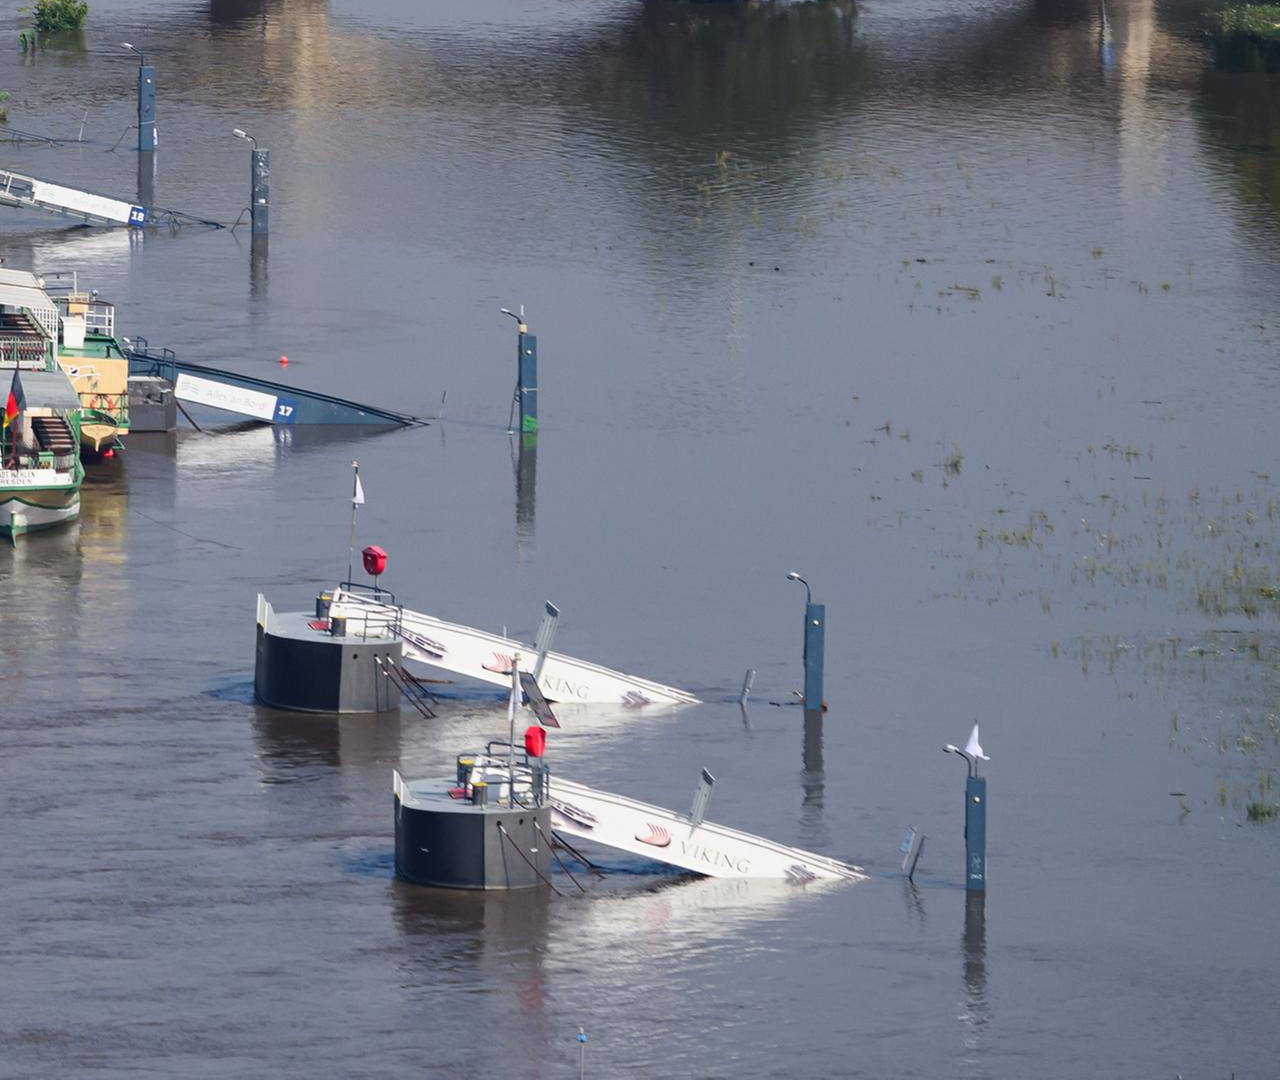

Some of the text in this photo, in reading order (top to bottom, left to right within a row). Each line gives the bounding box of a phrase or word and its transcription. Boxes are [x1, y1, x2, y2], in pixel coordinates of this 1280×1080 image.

[131, 211, 145, 221] 18
[278, 405, 293, 416] 17
[681, 840, 751, 873] VIKING
